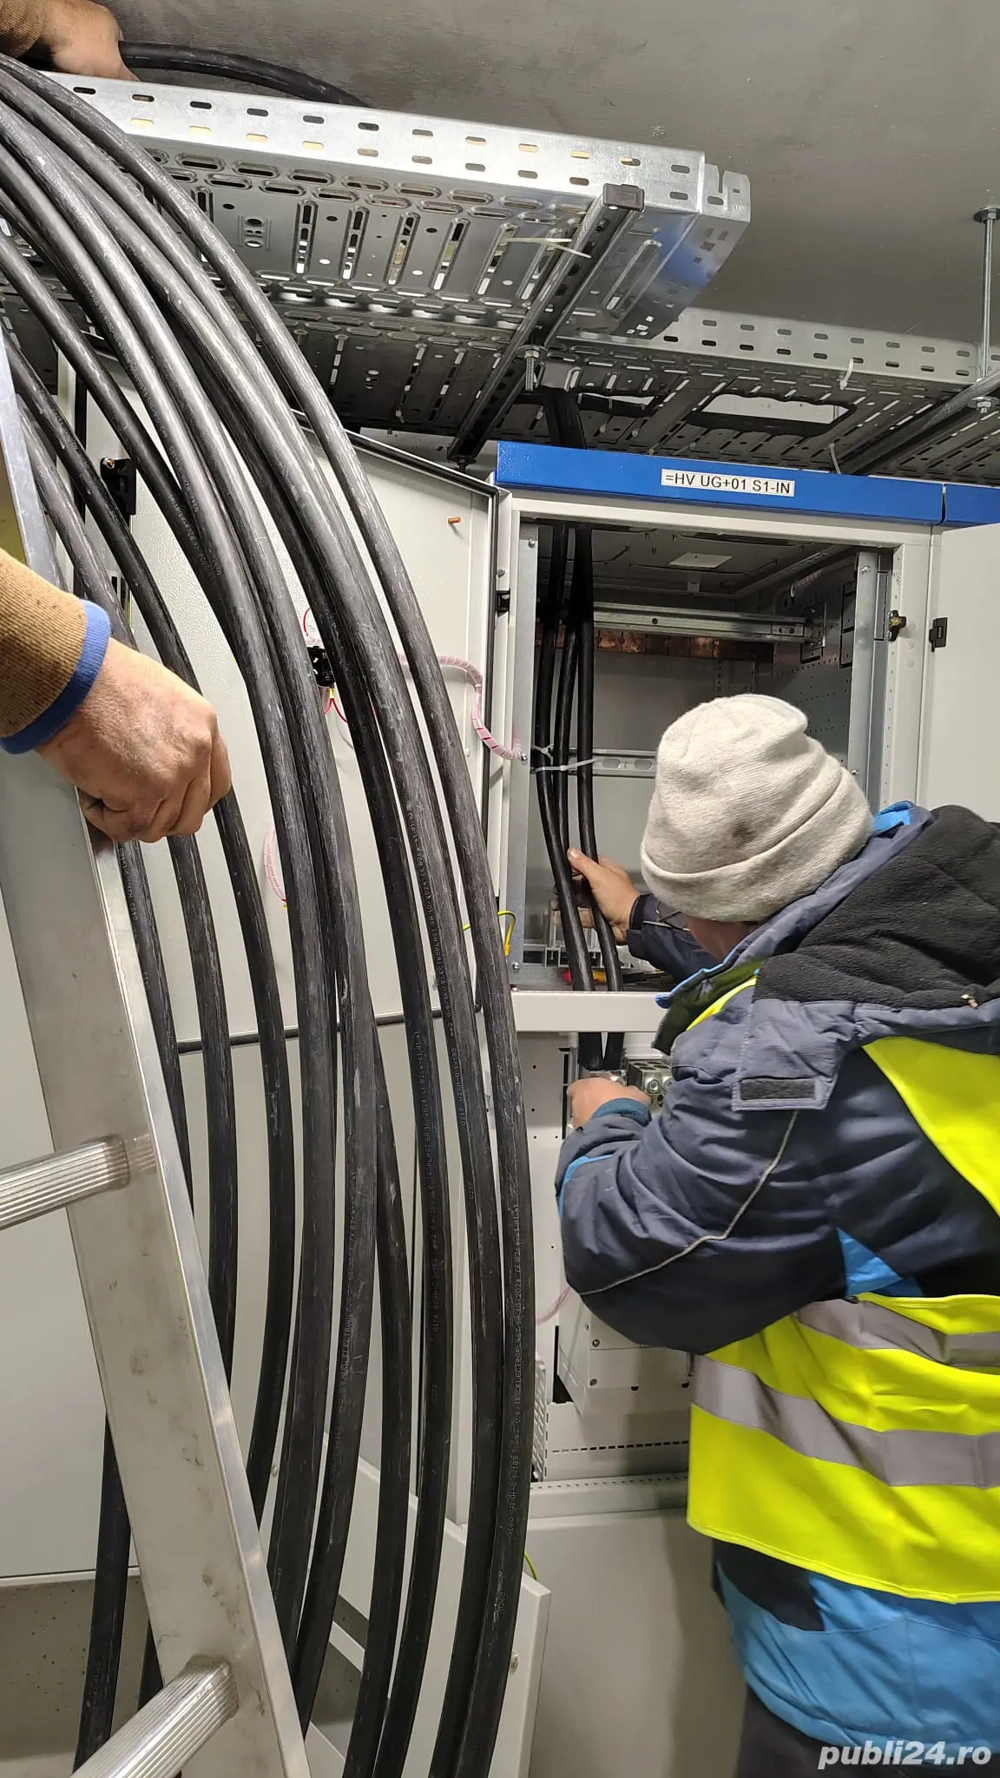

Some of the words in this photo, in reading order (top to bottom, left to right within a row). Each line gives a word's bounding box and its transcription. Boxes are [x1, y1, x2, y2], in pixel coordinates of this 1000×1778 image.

[665, 473, 695, 486] =HV
[700, 476, 746, 490] UG+01
[752, 480, 790, 494] S1-IN
